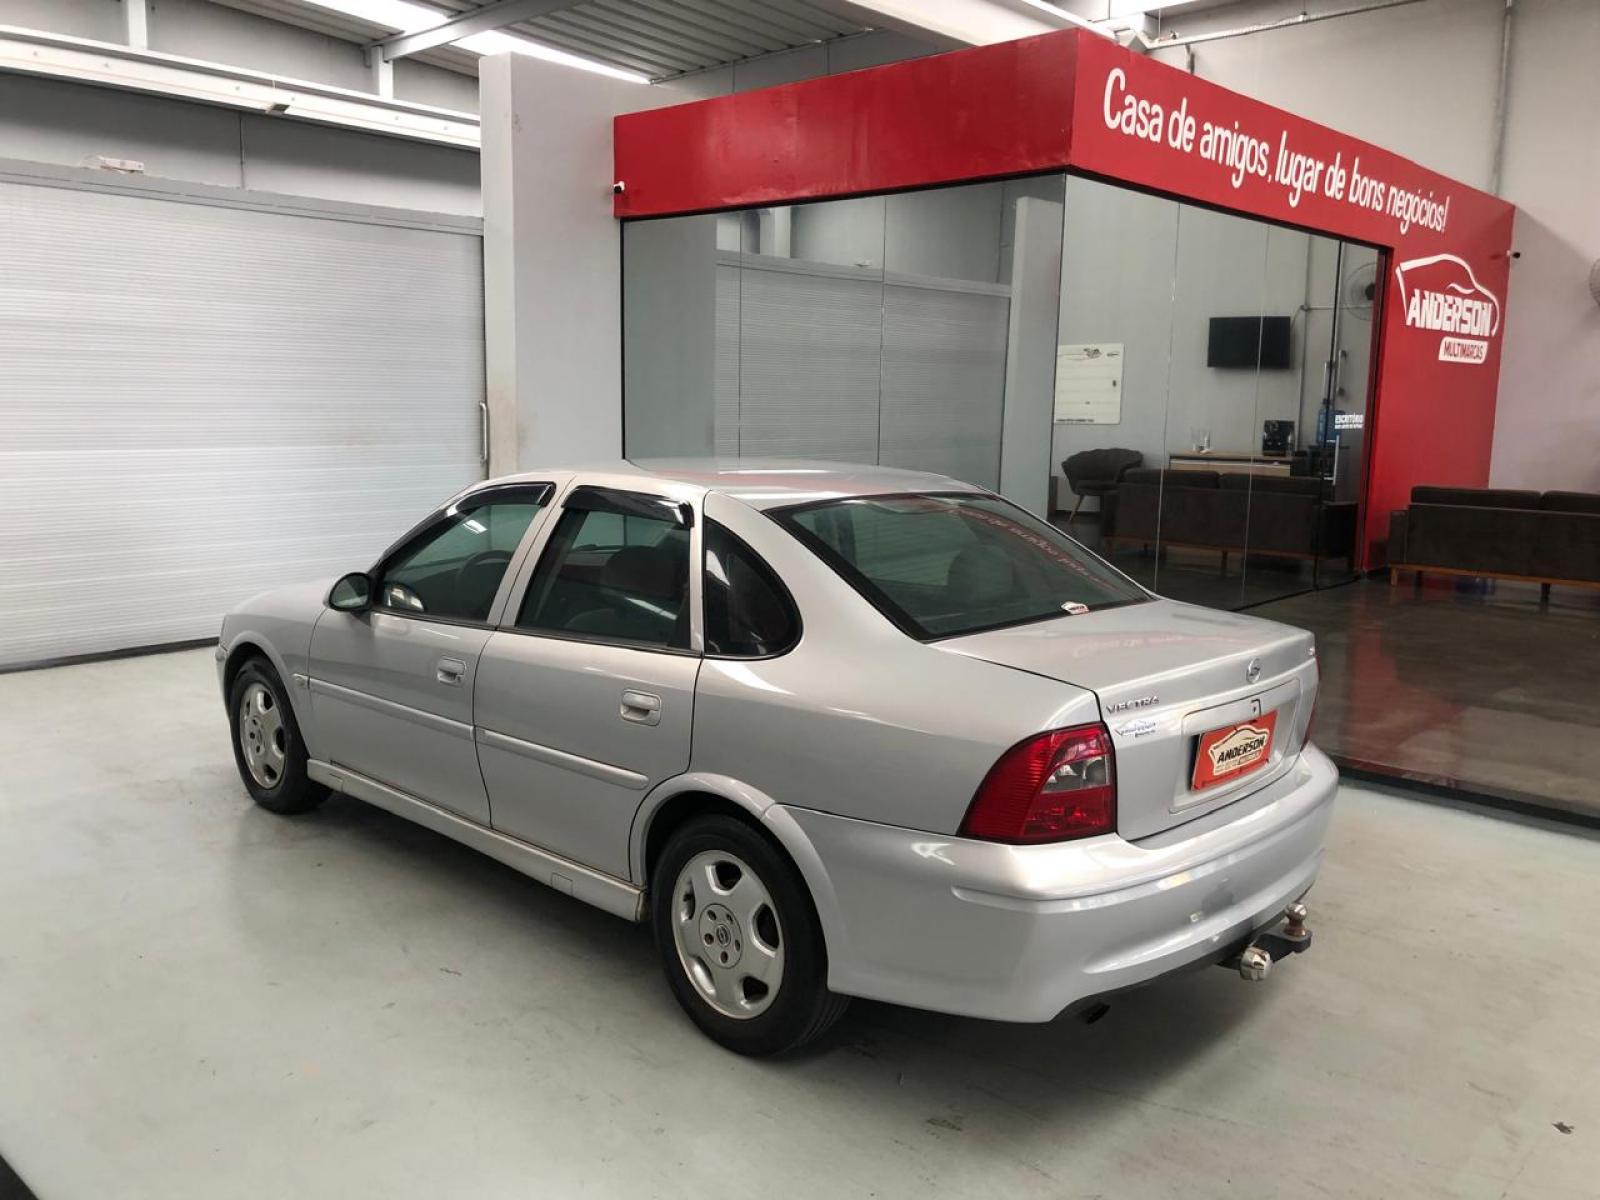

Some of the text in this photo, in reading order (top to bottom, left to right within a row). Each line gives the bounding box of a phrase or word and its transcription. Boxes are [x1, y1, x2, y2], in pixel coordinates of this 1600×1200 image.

[1103, 68, 1450, 235] Casa de amigos, lugar de bons negócios!
[1405, 288, 1492, 337] ANDERSON
[1106, 695, 1160, 714] VECTRA
[1217, 735, 1266, 764] ANDERSON
